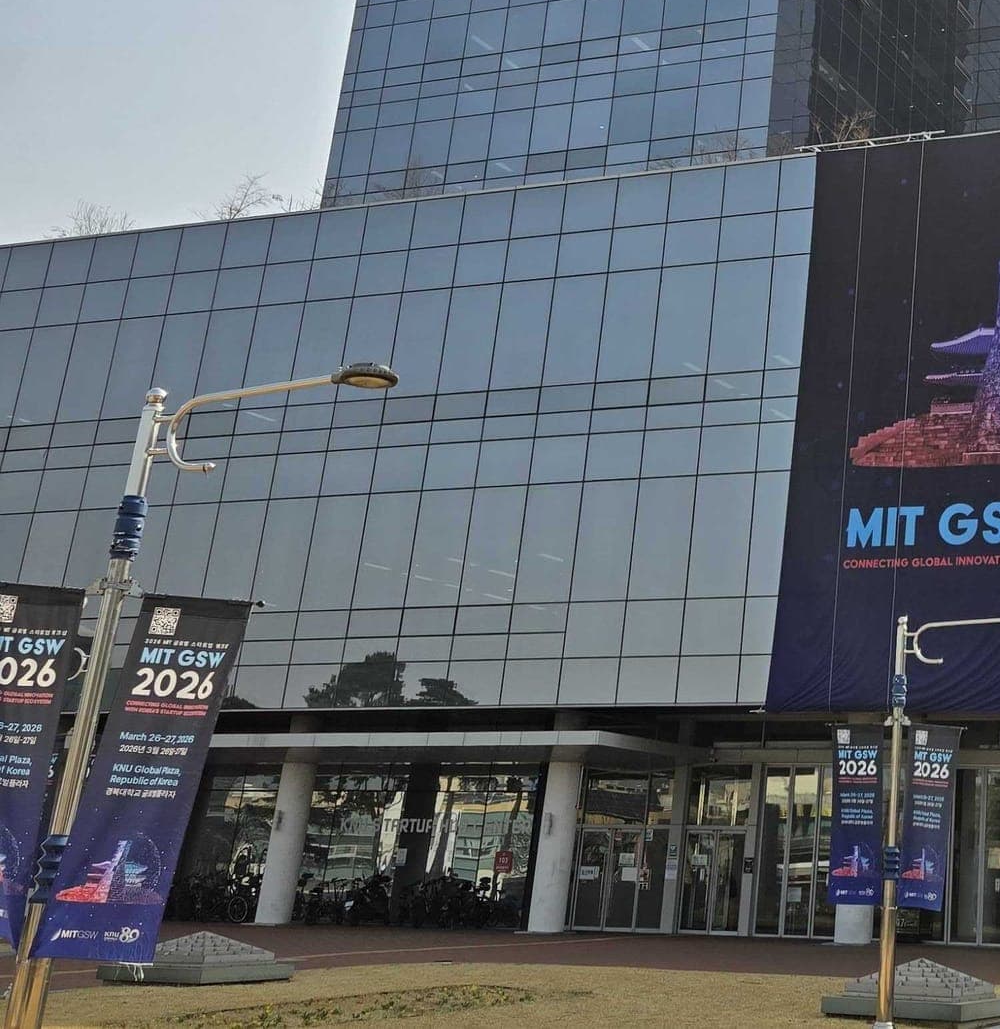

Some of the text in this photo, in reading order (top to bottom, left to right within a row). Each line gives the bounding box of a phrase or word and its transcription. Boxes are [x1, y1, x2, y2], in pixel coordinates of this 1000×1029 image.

[846, 506, 925, 549] MIT
[843, 557, 909, 569] CONNECTING
[912, 556, 953, 567] GLOBAL
[18, 637, 66, 655] GSW
[140, 647, 226, 669] MIT GSW
[0, 656, 56, 688] 026
[131, 667, 215, 700] 2026
[119, 731, 147, 742] March
[854, 750, 878, 759] GSW
[929, 752, 952, 763] GSW
[112, 763, 133, 773] KNU
[839, 760, 877, 776] 2026
[913, 761, 950, 779] 2026
[109, 774, 149, 786] Republic
[61, 929, 99, 940] MITGSW
